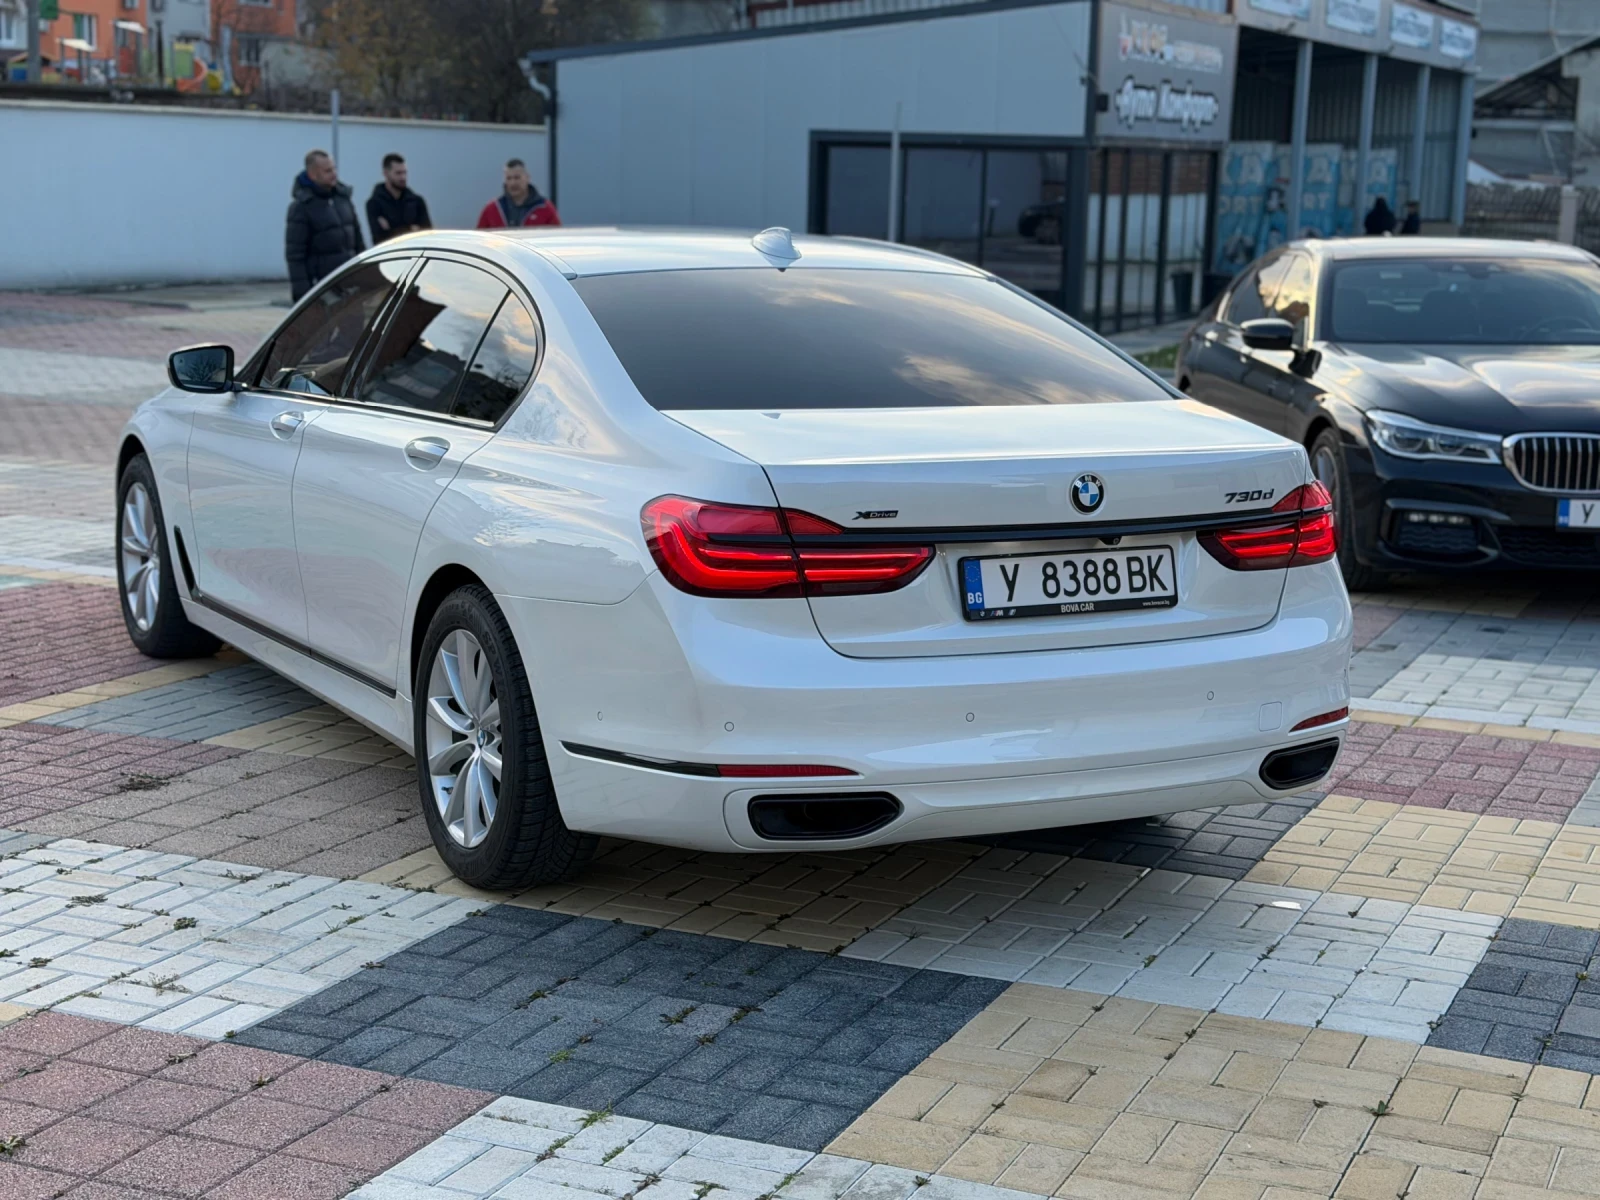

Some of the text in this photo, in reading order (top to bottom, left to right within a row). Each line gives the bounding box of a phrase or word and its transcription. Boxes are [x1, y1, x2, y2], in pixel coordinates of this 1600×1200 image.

[1224, 488, 1275, 505] 730d
[967, 592, 983, 605] BG
[1060, 602, 1095, 613] BOVA CAR
